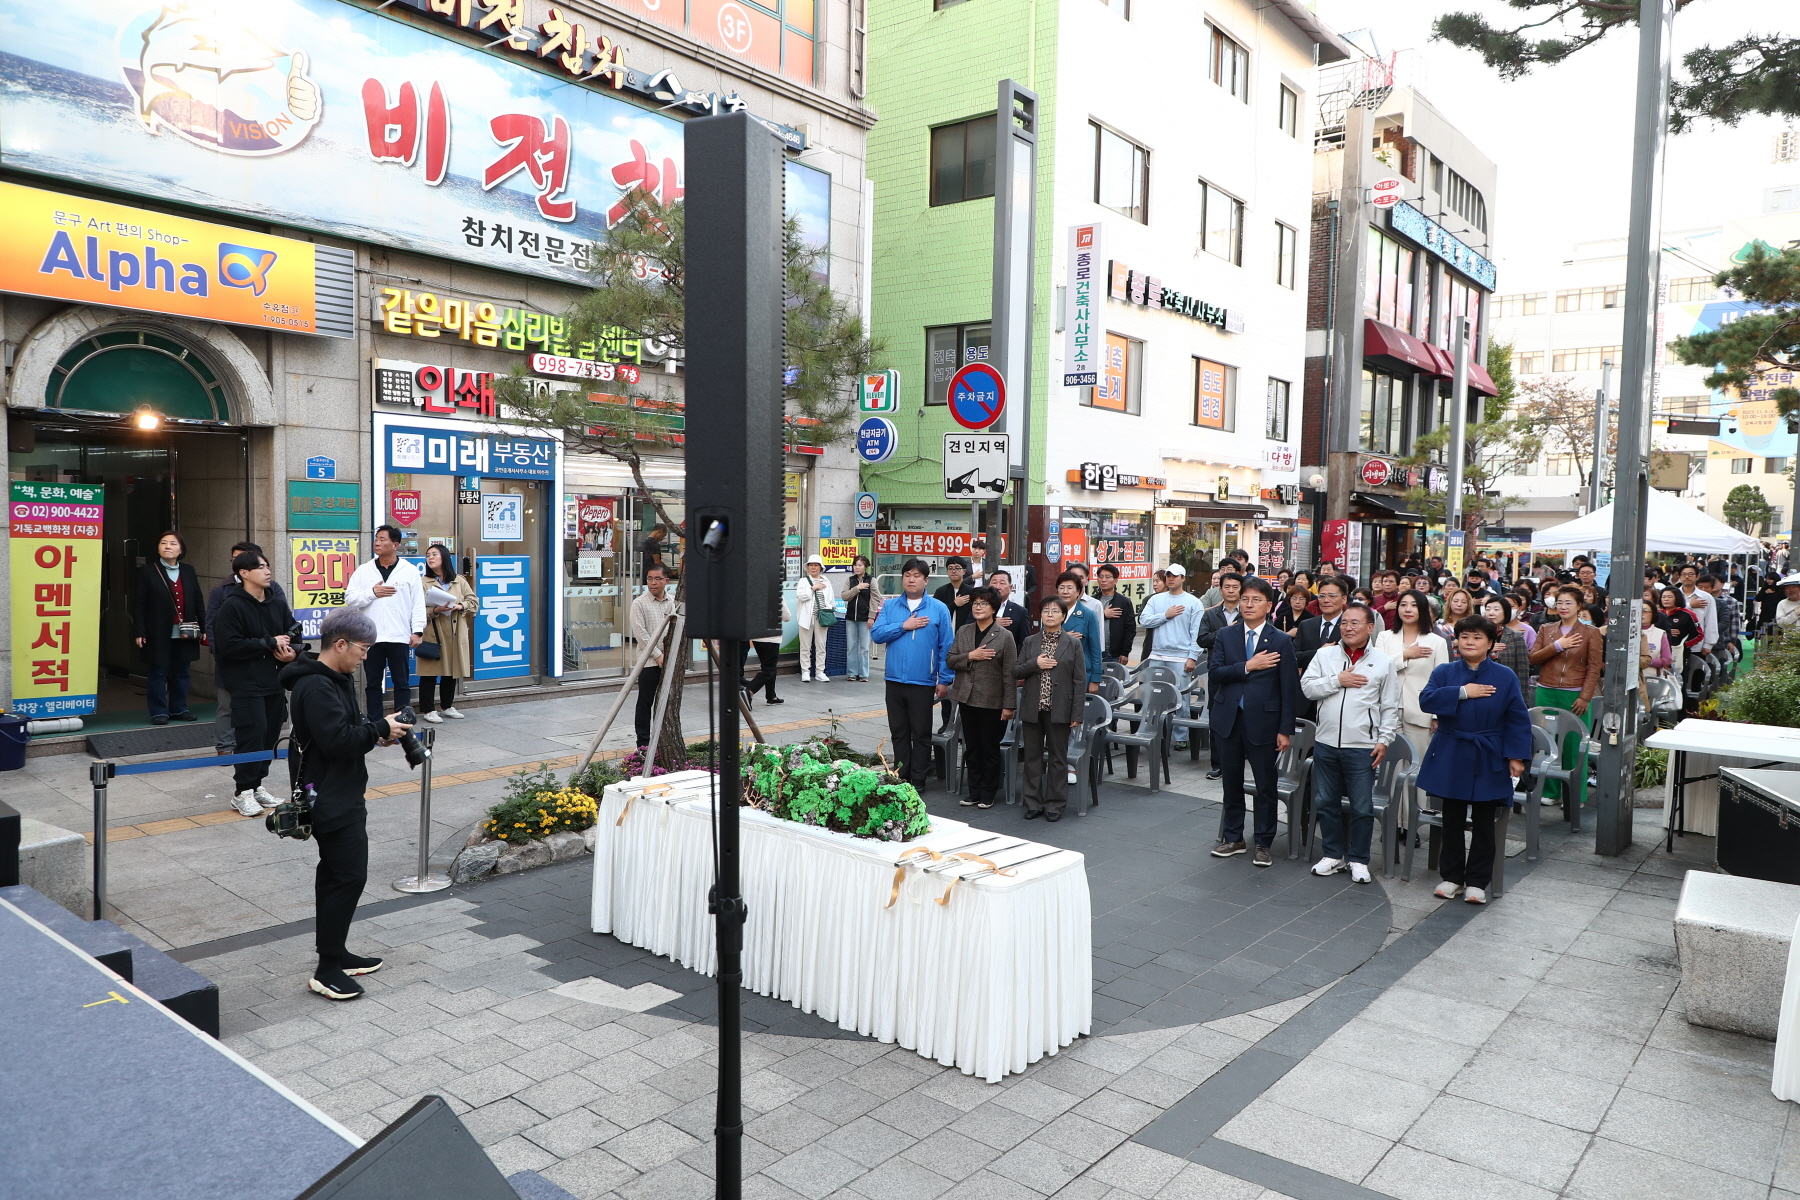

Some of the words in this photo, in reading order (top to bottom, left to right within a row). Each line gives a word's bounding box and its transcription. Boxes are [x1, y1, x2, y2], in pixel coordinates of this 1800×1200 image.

[723, 13, 748, 43] 3F
[229, 113, 294, 142] VISION
[53, 210, 83, 227] 문구
[87, 217, 112, 234] Art
[115, 222, 142, 239] 편의
[461, 215, 592, 272] 참치전문점
[38, 229, 209, 298] Alpha
[1064, 373, 1097, 386] 906-3456
[416, 365, 495, 418] 인쇄
[866, 391, 885, 399] ELEVEN
[867, 376, 885, 409] 7
[957, 391, 995, 402] 주차금지
[866, 439, 880, 447] ATM
[949, 440, 1006, 454] 견인지역
[428, 435, 490, 474] 미래
[493, 441, 551, 467] 부동산
[1271, 452, 1293, 466] 다방
[318, 467, 326, 477] 5
[1083, 463, 1118, 492] 한일
[459, 491, 480, 504] 부동산
[32, 505, 49, 519] 02)
[51, 506, 100, 519] 900-4422
[583, 504, 609, 521] Pepero
[860, 500, 874, 511] 담배
[13, 523, 71, 536] 기독교백화점
[73, 525, 99, 536] (지층)
[487, 523, 517, 531] 미래부동산
[300, 540, 351, 552] 사무실
[877, 534, 899, 551] 한일
[902, 534, 935, 553] 부동산
[1063, 544, 1082, 556] 한일
[1259, 541, 1285, 554] 강북
[1258, 555, 1285, 568] 다방
[295, 553, 356, 591] 임대
[1121, 565, 1148, 578] 999-0700
[308, 592, 346, 606] 73평
[31, 545, 78, 693] 아멘서적
[479, 561, 525, 664] 부동산
[45, 698, 96, 713] 엘리베이터
